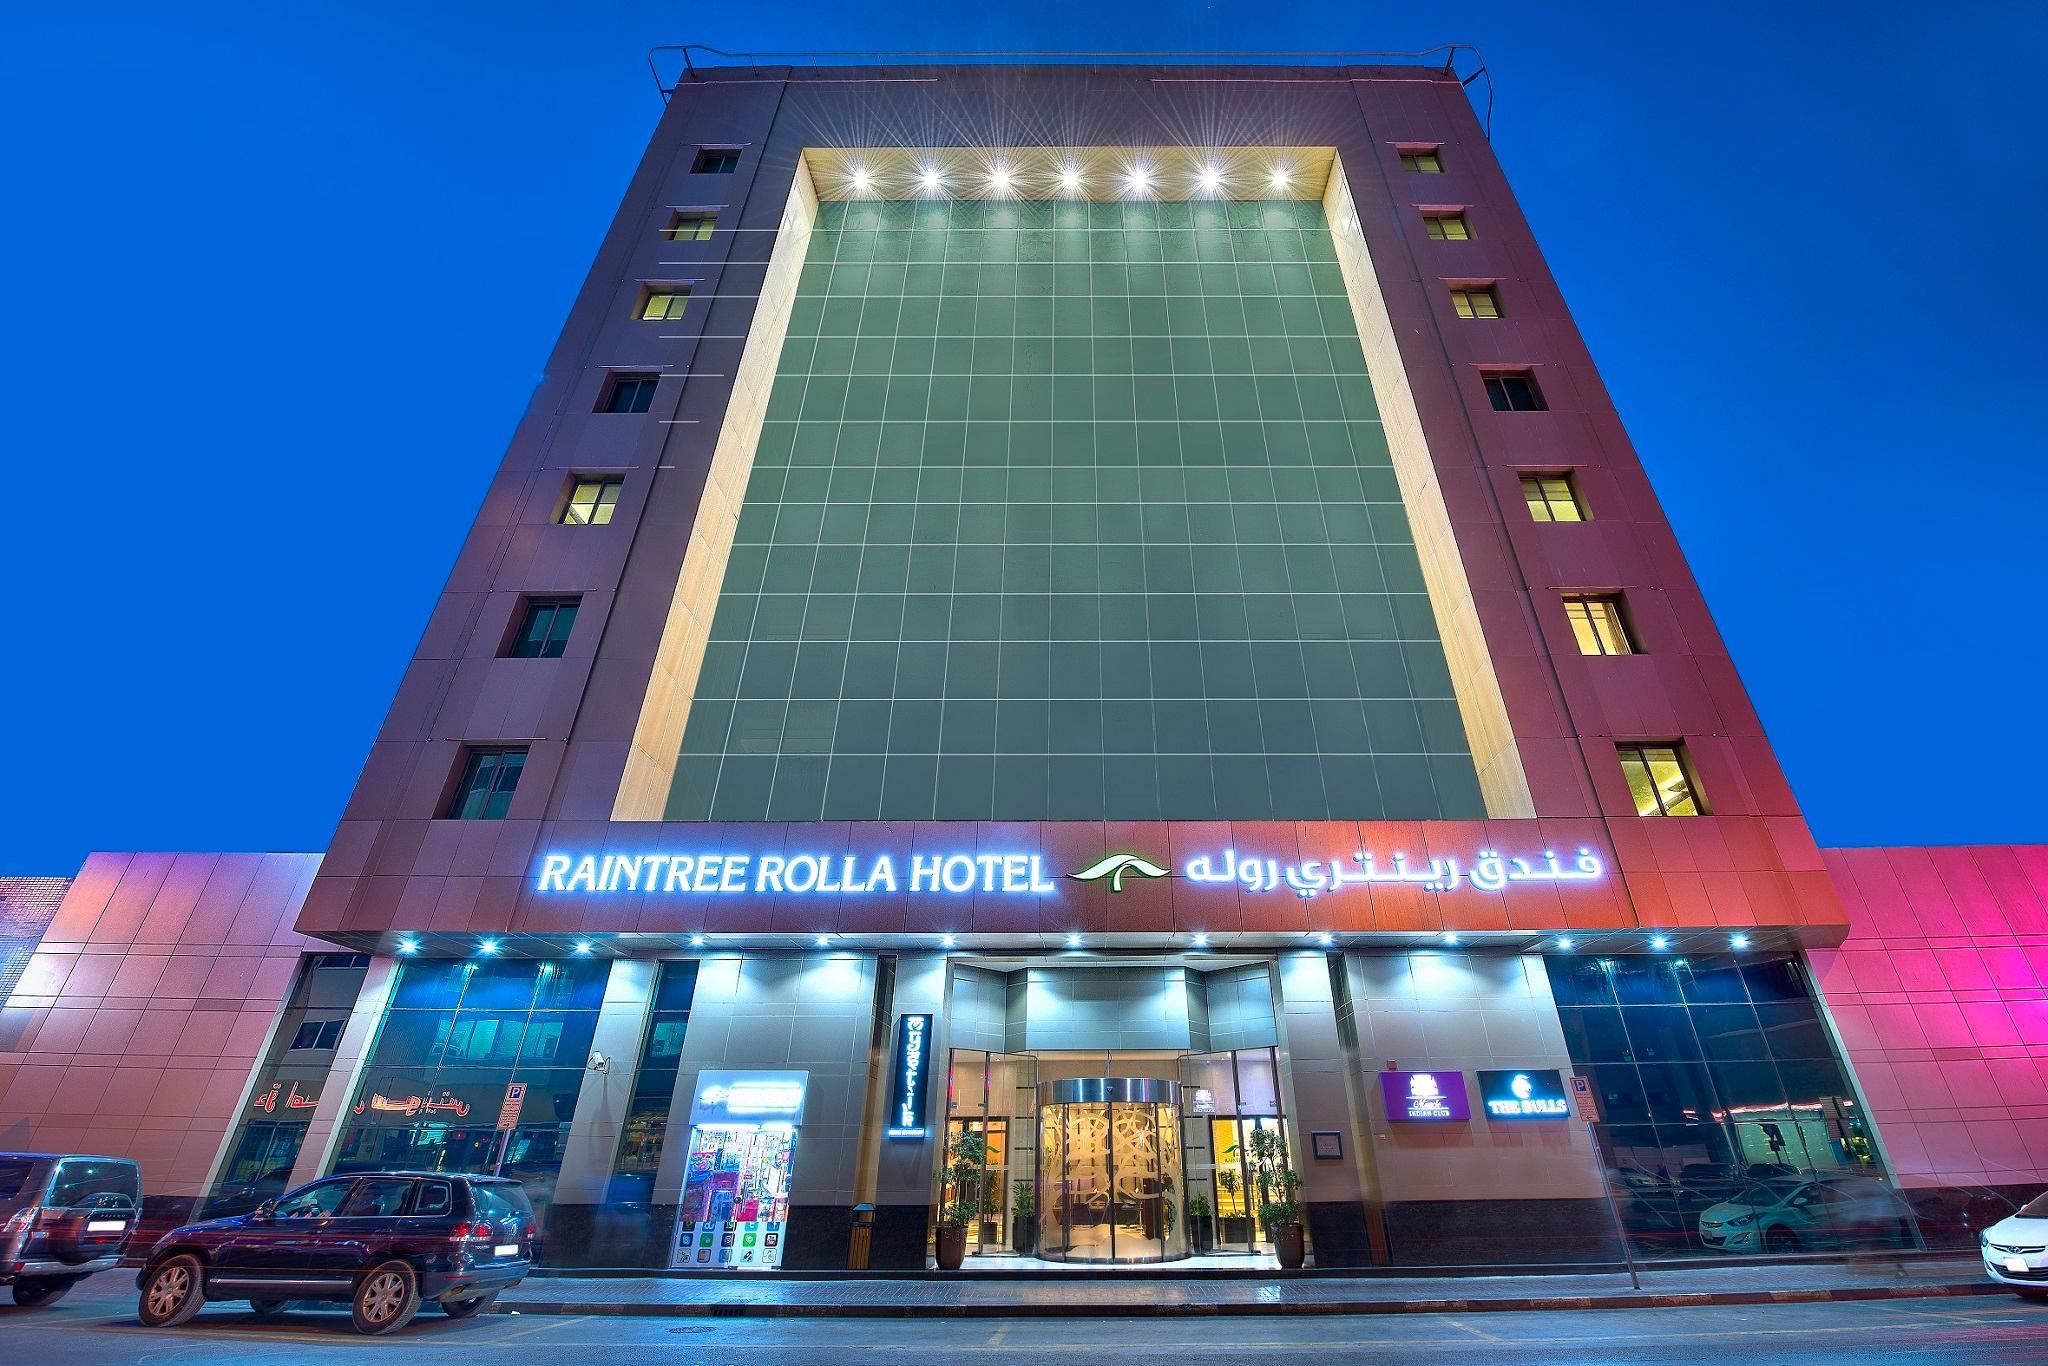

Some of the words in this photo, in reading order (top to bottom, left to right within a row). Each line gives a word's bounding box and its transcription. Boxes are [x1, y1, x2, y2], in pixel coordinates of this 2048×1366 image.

[537, 855, 750, 892] RAINTREE
[754, 855, 897, 892] ROLLA
[909, 855, 1055, 892] HOTEL
[1285, 852, 1459, 899] رينتري
[1468, 848, 1602, 891] فندق
[511, 1087, 521, 1098] P
[1575, 1081, 1585, 1091] P
[1488, 1100, 1520, 1113] THE
[1521, 1099, 1568, 1113] BULLS
